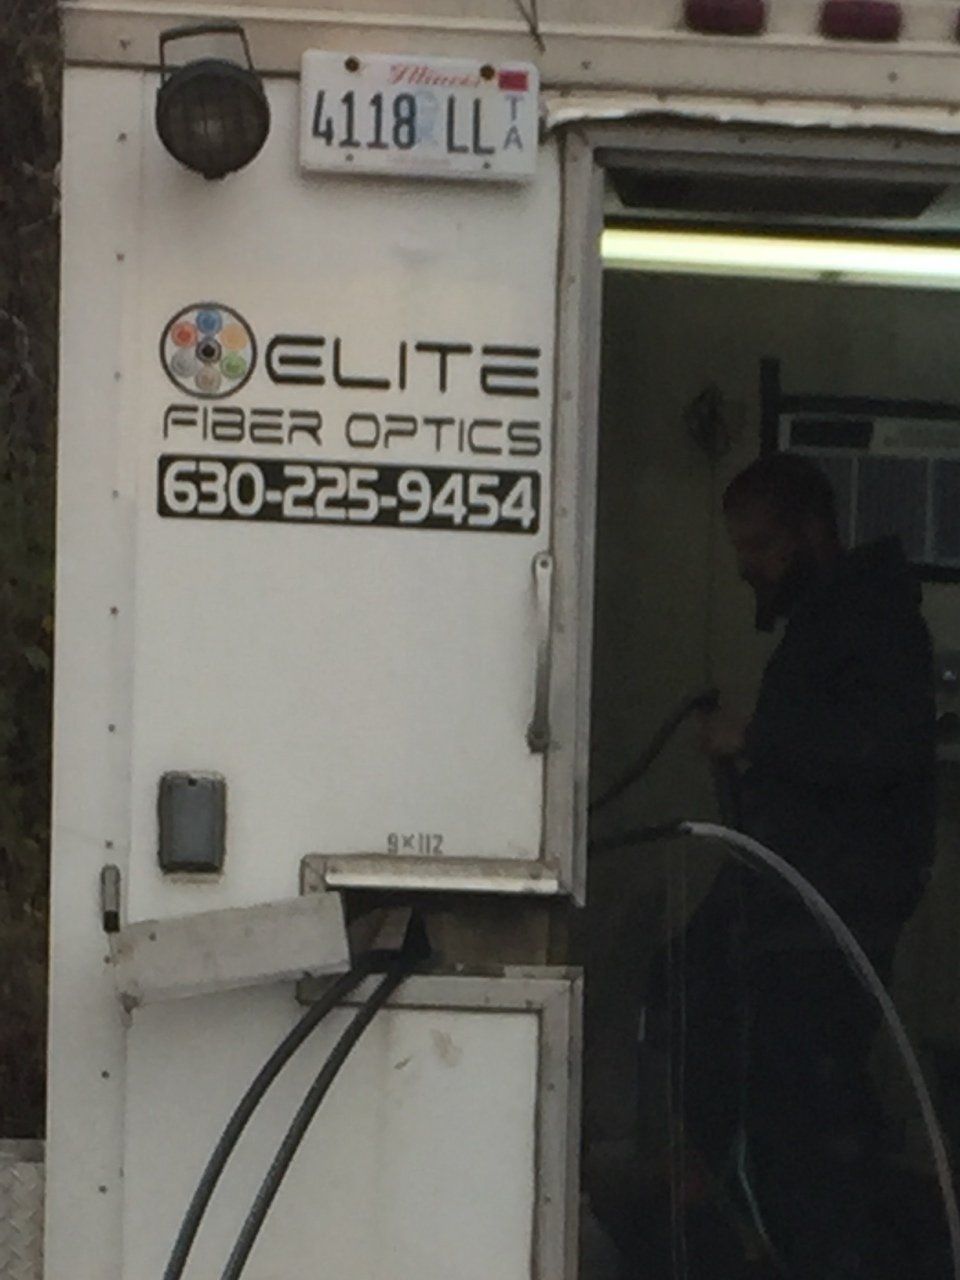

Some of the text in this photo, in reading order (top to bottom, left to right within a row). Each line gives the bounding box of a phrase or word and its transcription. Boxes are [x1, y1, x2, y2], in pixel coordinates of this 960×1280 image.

[312, 90, 495, 155] 4118 LL
[265, 334, 541, 397] ELITE
[163, 404, 542, 456] FIBER OPTICS
[163, 460, 536, 529] 630-225-9454
